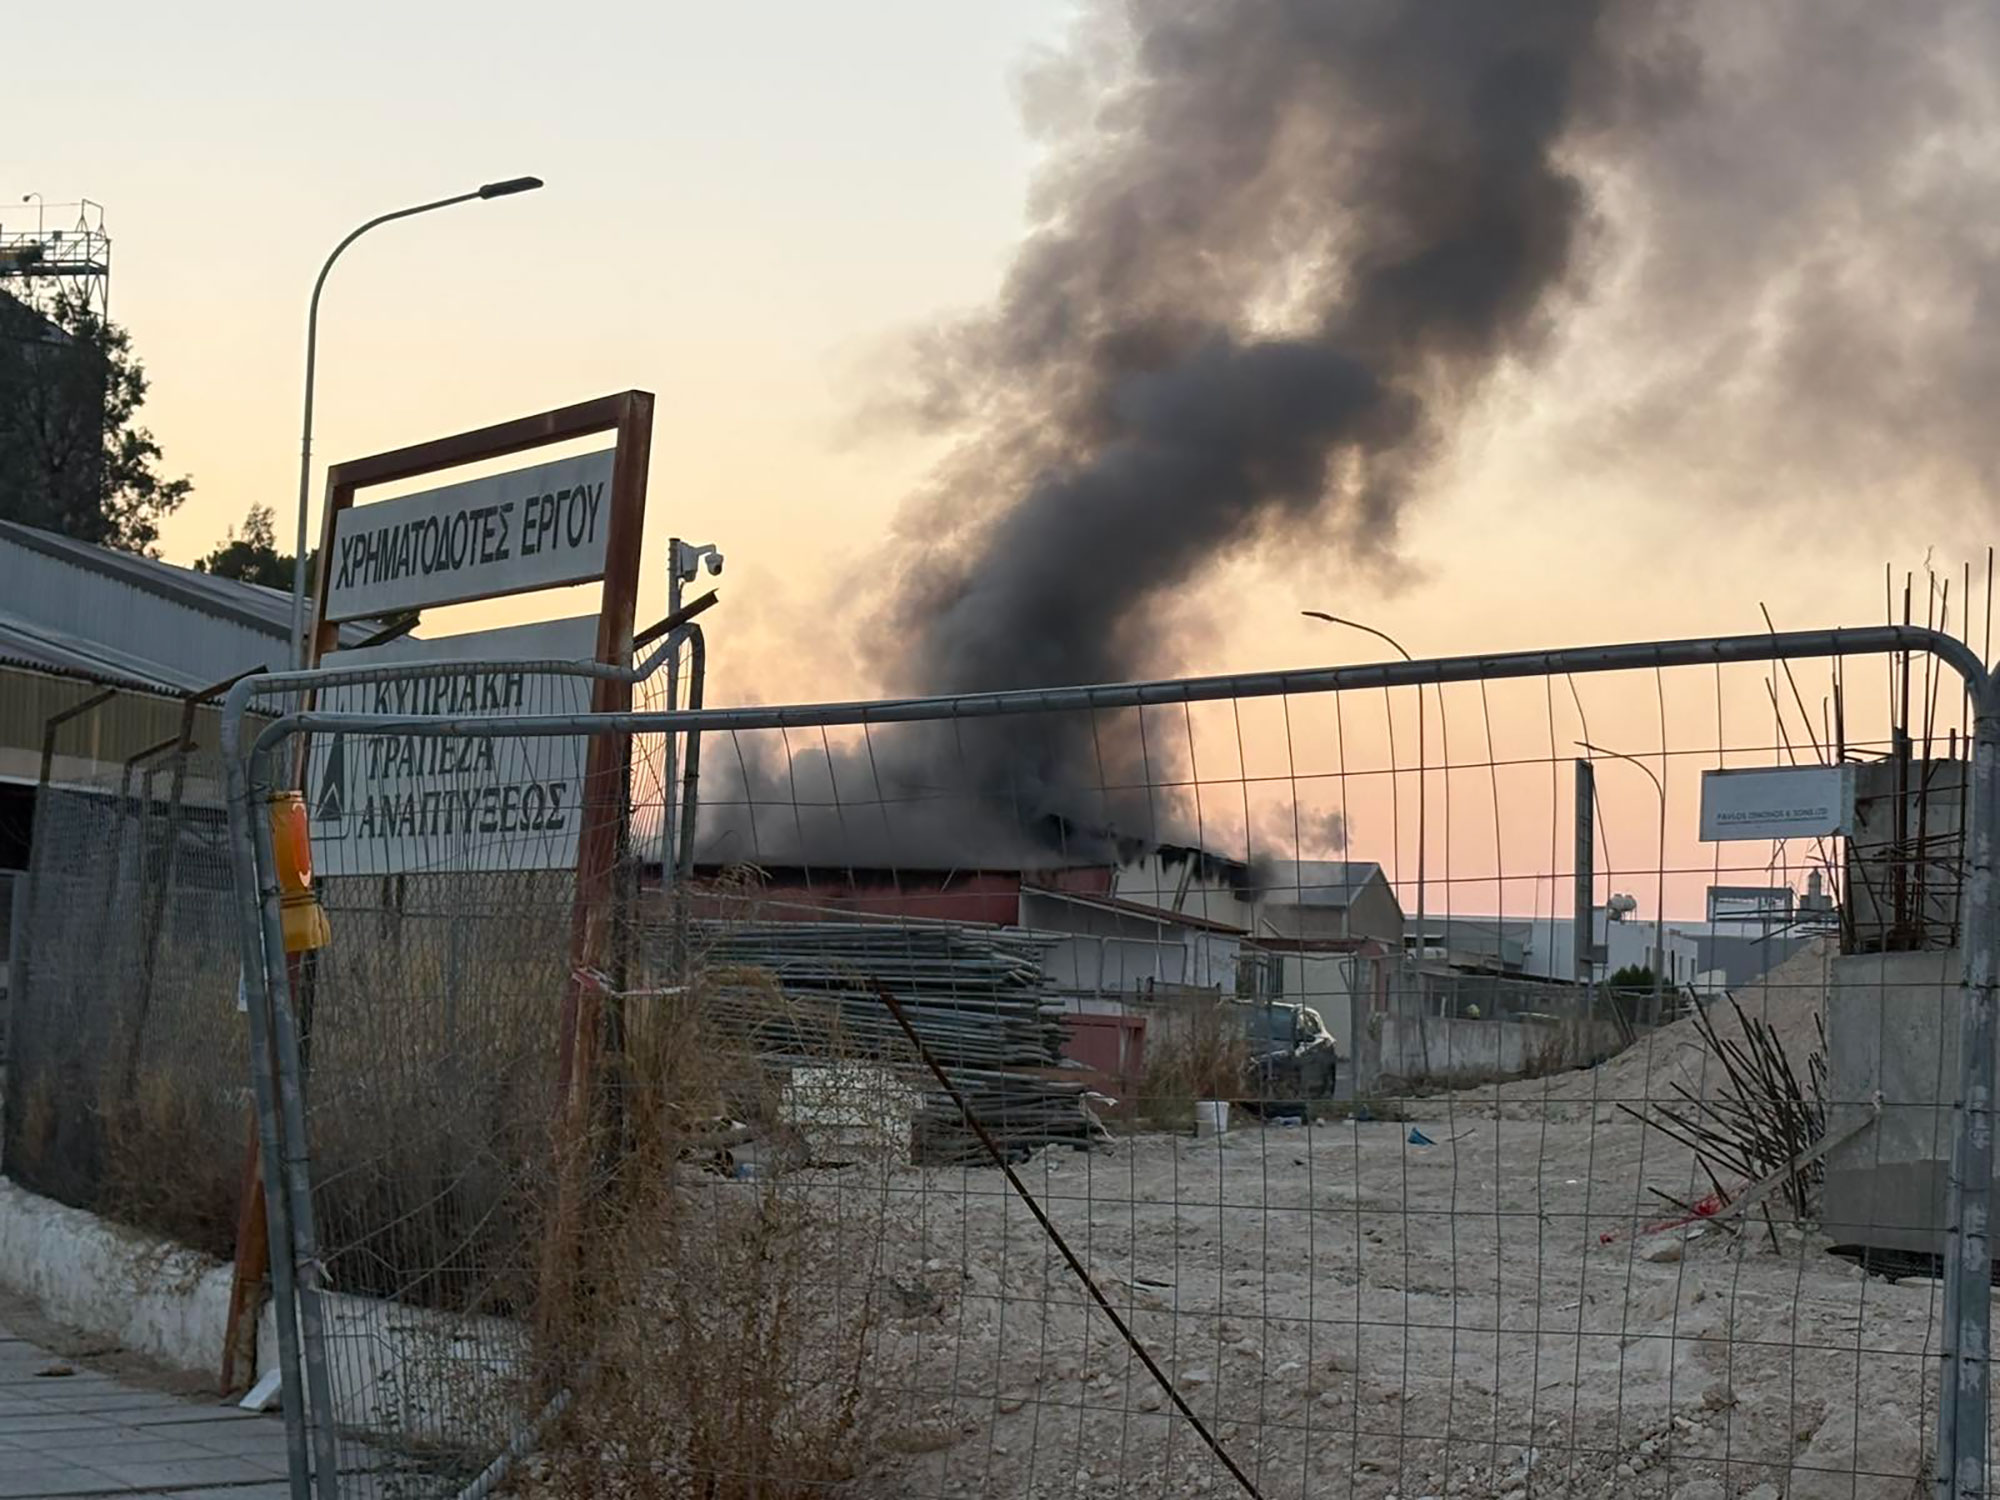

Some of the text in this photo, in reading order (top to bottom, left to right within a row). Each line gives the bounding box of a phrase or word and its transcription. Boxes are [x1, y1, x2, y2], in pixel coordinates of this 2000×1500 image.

[336, 482, 604, 590] ΧΡΗΜΑΤΟΔΟΤΕΣ ΕΡΓΟΥ
[373, 671, 524, 715] ΚΥΠΡΙΑΚΗ
[368, 736, 494, 780] ΤΡΑΠΕΖΑ
[358, 782, 568, 839] ΑΝΑΠΤΥΞΕΩΣ
